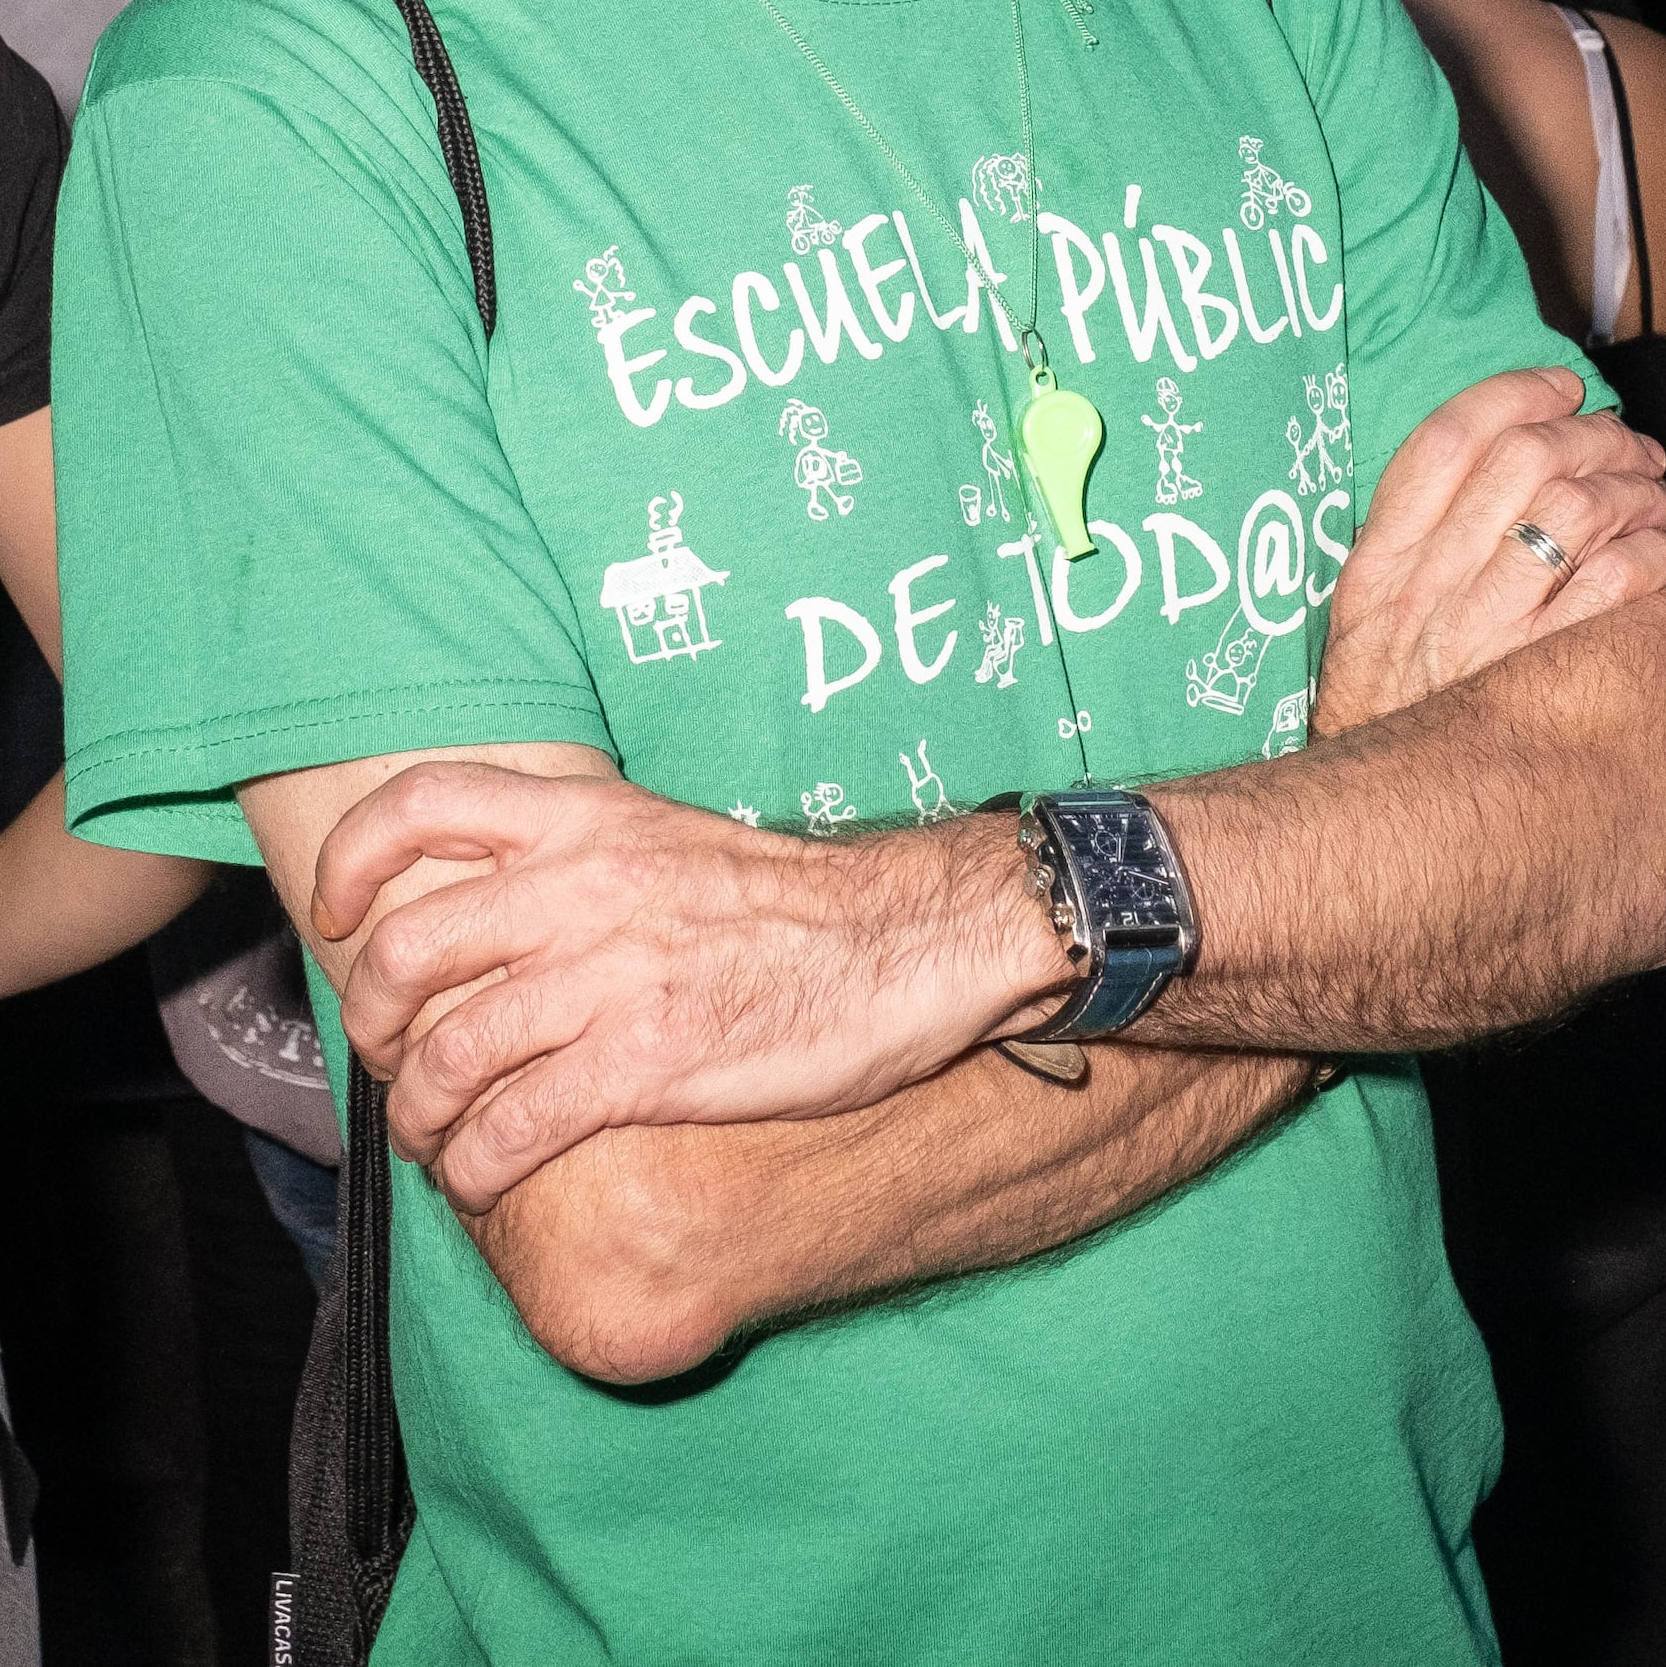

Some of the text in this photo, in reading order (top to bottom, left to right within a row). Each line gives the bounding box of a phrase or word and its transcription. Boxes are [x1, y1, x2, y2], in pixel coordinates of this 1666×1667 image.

[597, 198, 1018, 427] ESCUELA
[785, 489, 1351, 713] DE TOD@S
